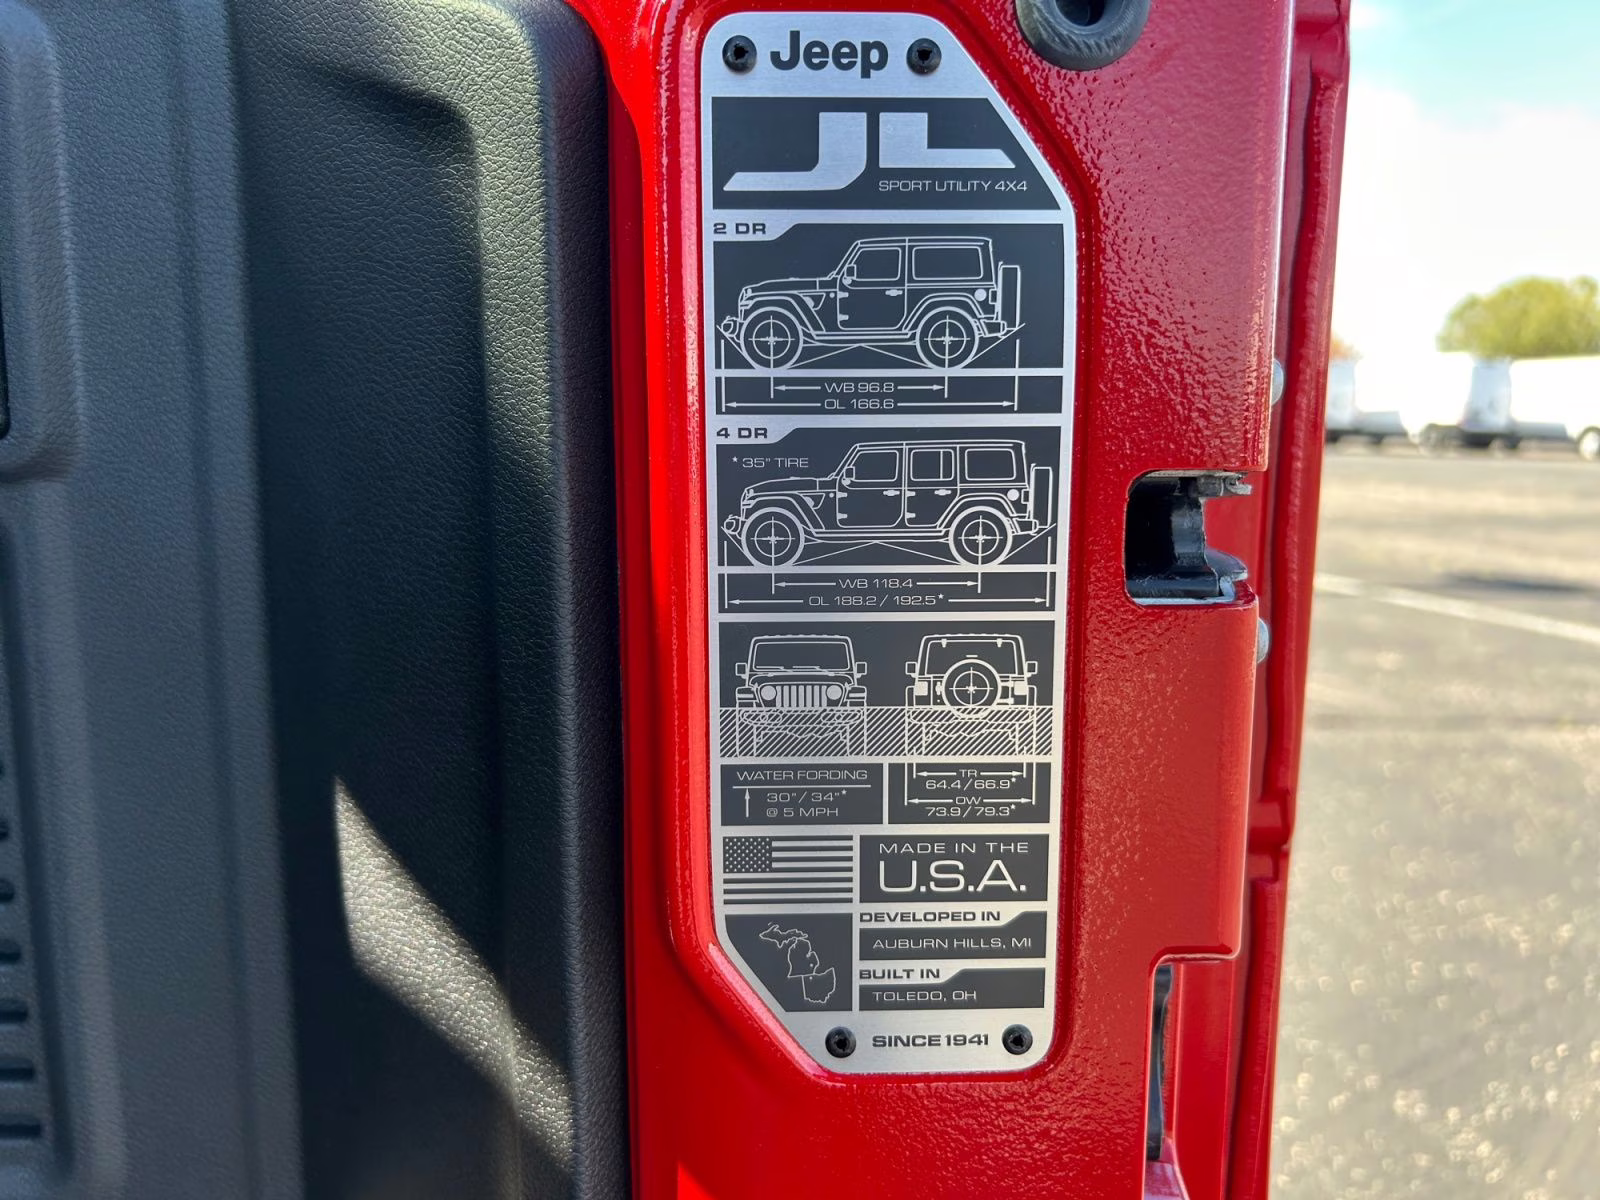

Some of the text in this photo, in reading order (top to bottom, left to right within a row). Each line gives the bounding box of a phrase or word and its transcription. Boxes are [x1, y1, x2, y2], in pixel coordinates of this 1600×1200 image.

[770, 30, 888, 79] Jeep
[723, 112, 1016, 192] JL
[879, 181, 1027, 191] SPORT UTILITY 4X4
[714, 223, 766, 234] 2 DR
[825, 382, 894, 392] WB 96.8
[825, 399, 894, 409] OL 166.6
[717, 428, 767, 438] 4 DR
[775, 458, 808, 467] TIRE
[839, 579, 913, 588] WB 118.4
[809, 596, 830, 605] OL
[834, 596, 876, 605] 188.2
[737, 770, 867, 780] WATER FORDING
[959, 769, 977, 777] TR
[767, 808, 838, 817] @ 5 MPH
[880, 842, 1028, 853] MADE IN THE
[880, 860, 1026, 892] U.S.A.
[860, 911, 1000, 923] DEVELOPED IN
[873, 938, 1031, 948] AUBURN HILLS, MI
[859, 969, 939, 980] BUILT IN
[873, 991, 976, 1002] TOLEDO, OH
[872, 1034, 988, 1047] SINCE 1941
